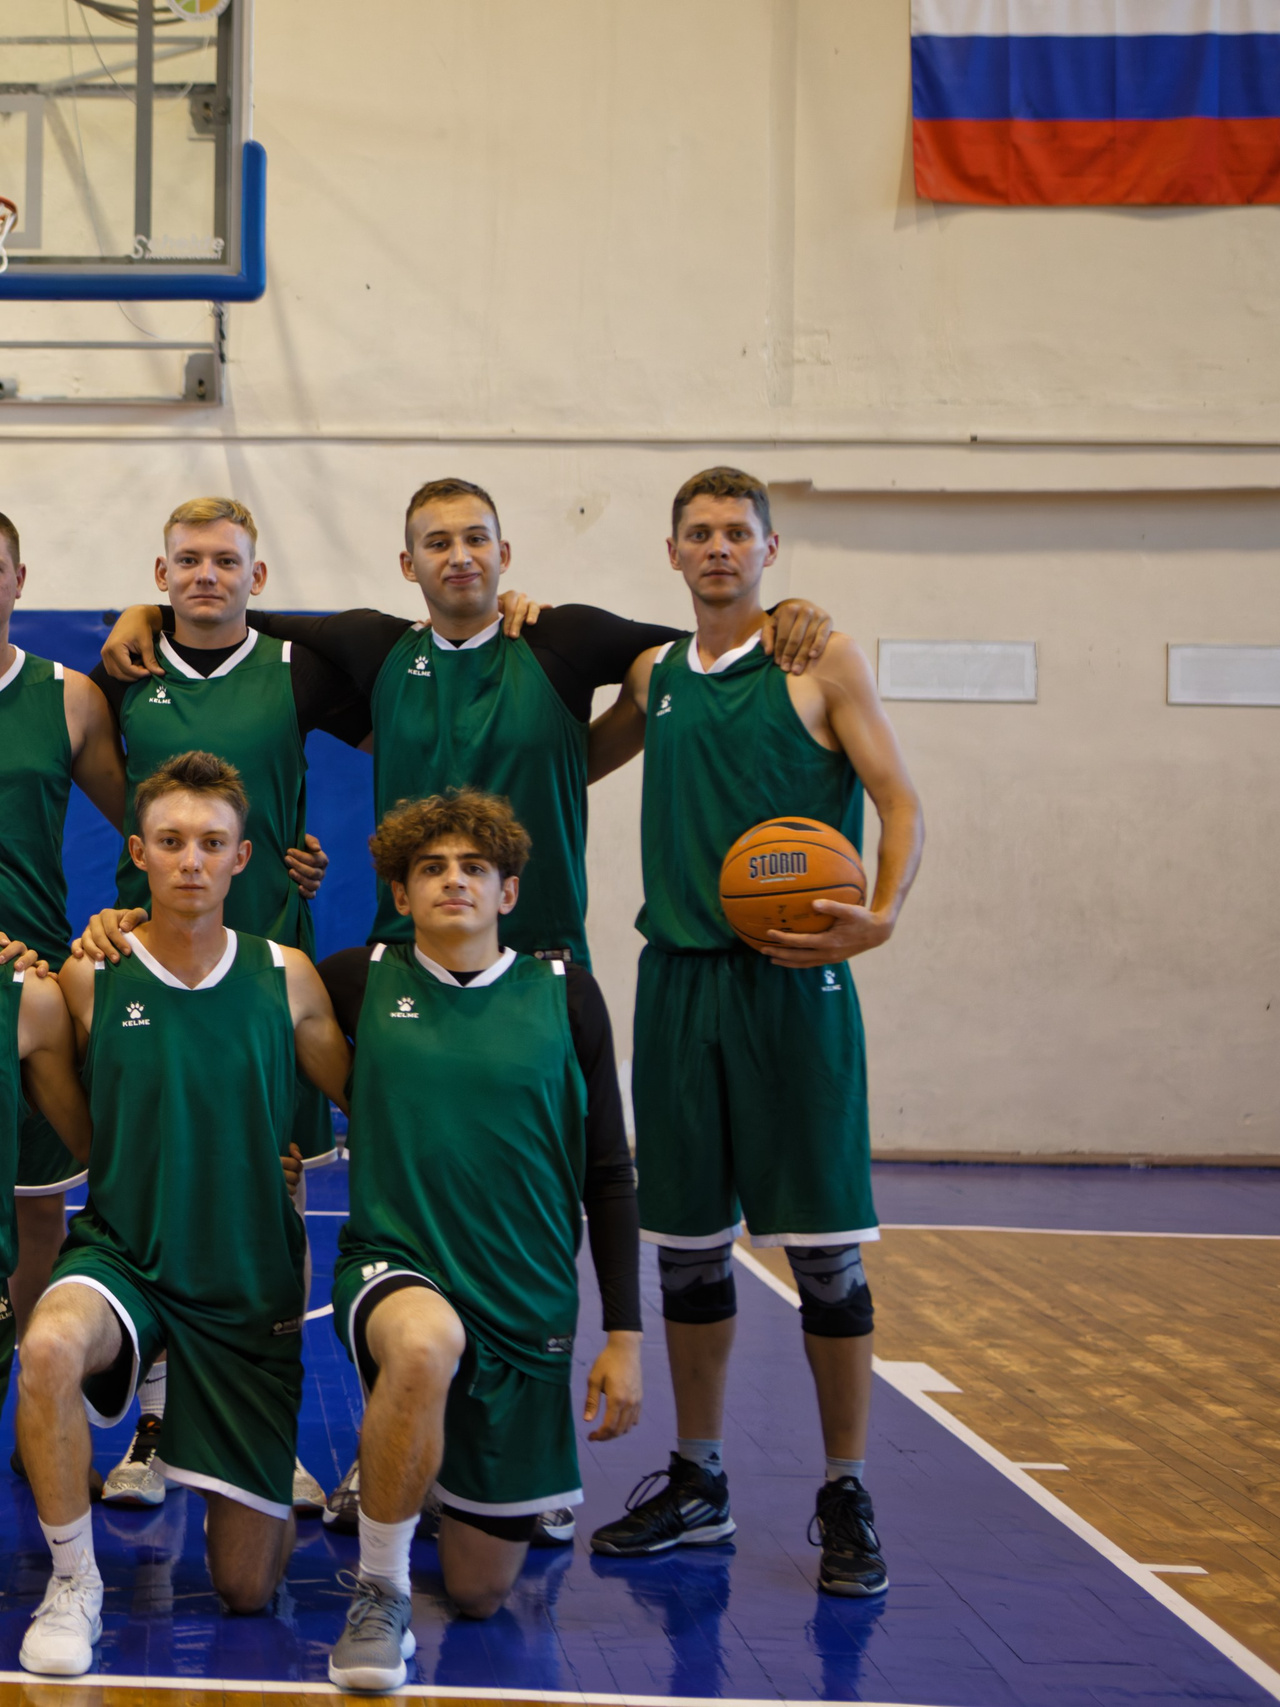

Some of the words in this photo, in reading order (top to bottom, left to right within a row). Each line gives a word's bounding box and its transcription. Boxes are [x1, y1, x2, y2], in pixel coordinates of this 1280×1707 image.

[148, 697, 172, 705] KELME
[749, 852, 807, 879] STORM
[389, 1011, 420, 1019] KELME
[122, 1018, 151, 1027] KELME
